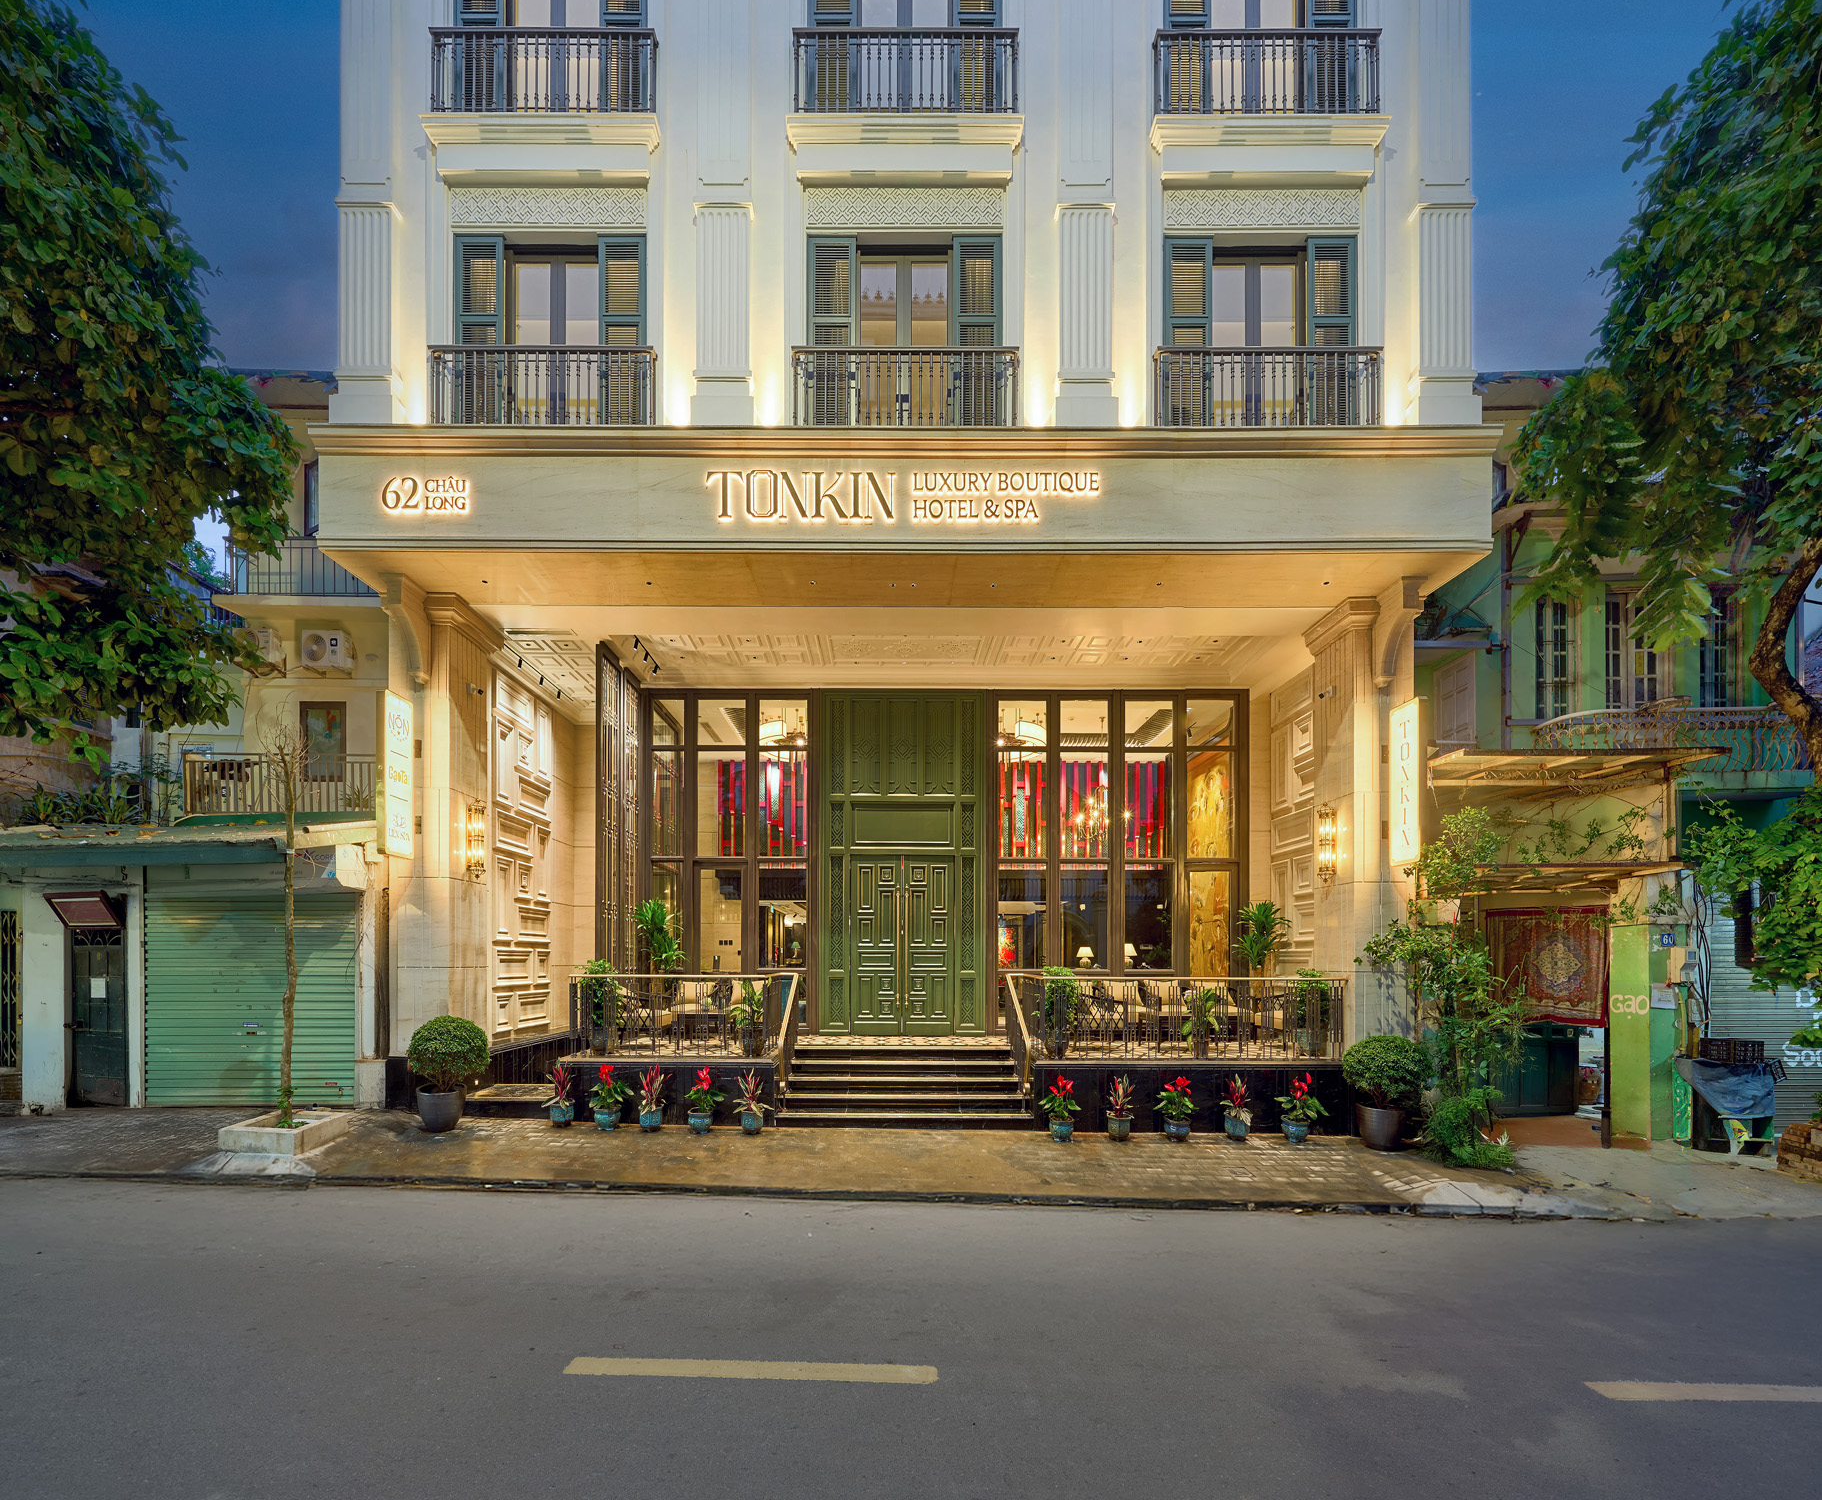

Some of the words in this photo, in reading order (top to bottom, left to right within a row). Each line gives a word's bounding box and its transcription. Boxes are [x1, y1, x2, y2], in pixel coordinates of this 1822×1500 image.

[424, 476, 466, 493] CHÂU
[913, 472, 993, 492] LUXURY
[997, 472, 1100, 492] BOUTIQUE
[381, 476, 420, 510] 62
[424, 496, 466, 510] LONG
[706, 469, 895, 519] TONKIN
[913, 499, 979, 519] HOTEL
[984, 499, 1000, 519] &
[1004, 499, 1039, 519] SPA
[1399, 719, 1411, 847] TONKIN
[1662, 935, 1674, 944] 60
